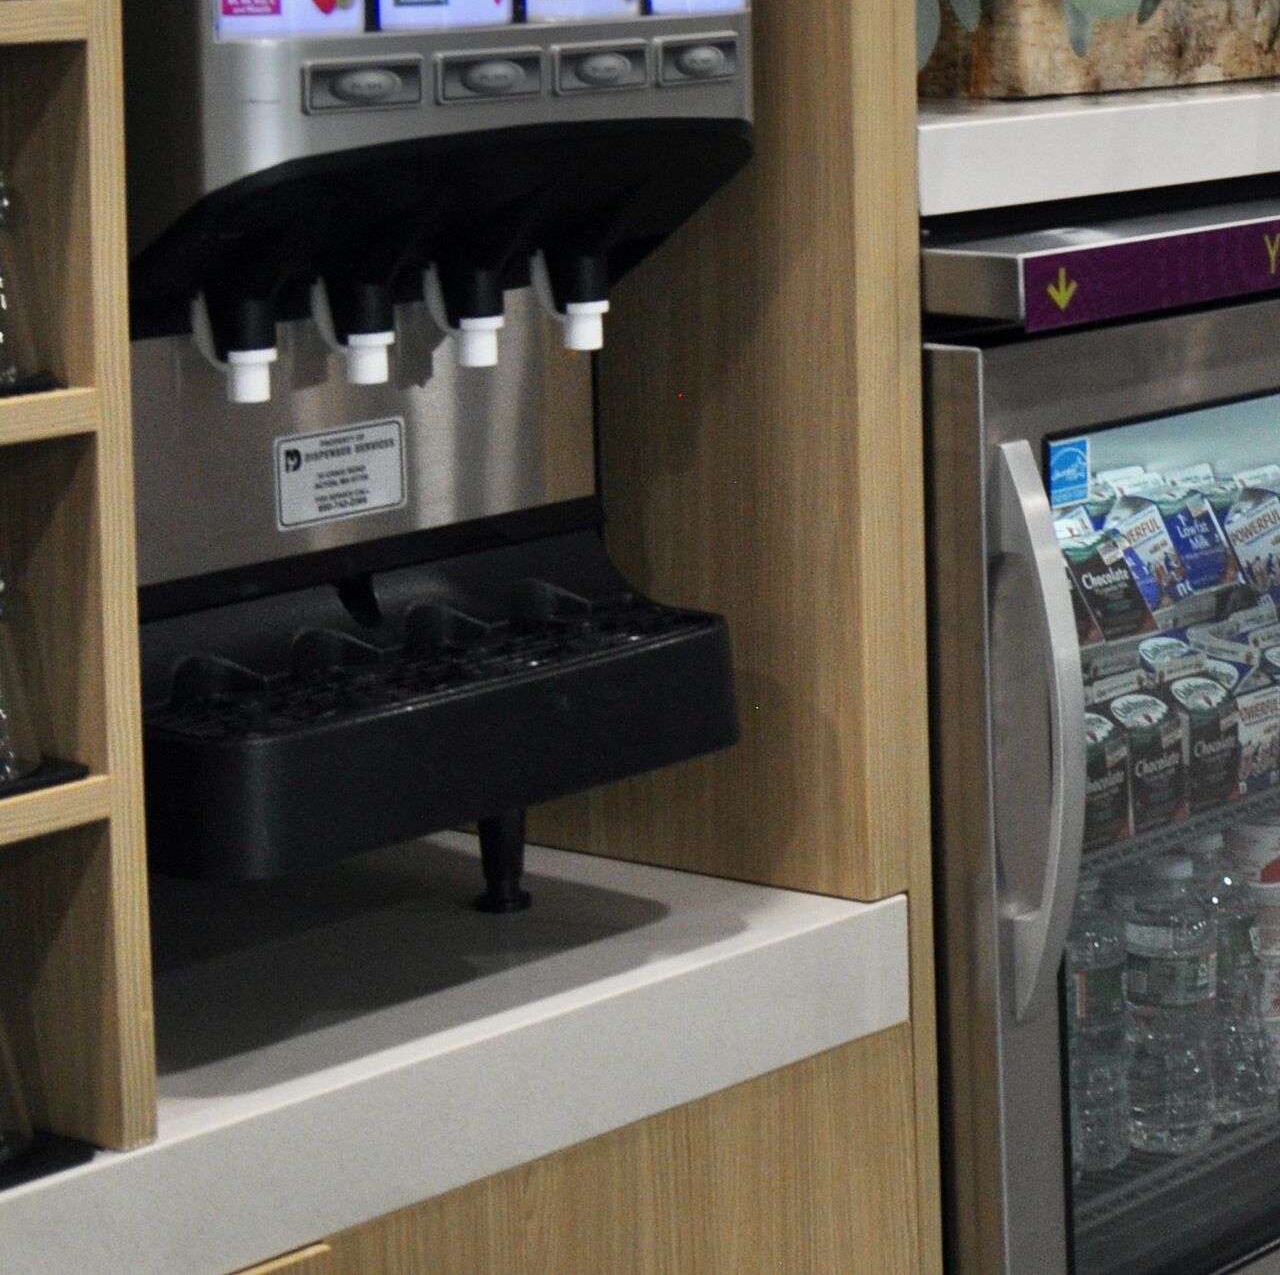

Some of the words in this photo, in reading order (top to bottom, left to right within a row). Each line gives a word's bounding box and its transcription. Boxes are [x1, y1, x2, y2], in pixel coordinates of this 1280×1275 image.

[1177, 521, 1209, 539] Lowfat
[1189, 535, 1211, 550] Milk
[1082, 568, 1130, 589] Chocolate
[1135, 752, 1180, 778] Chocolate
